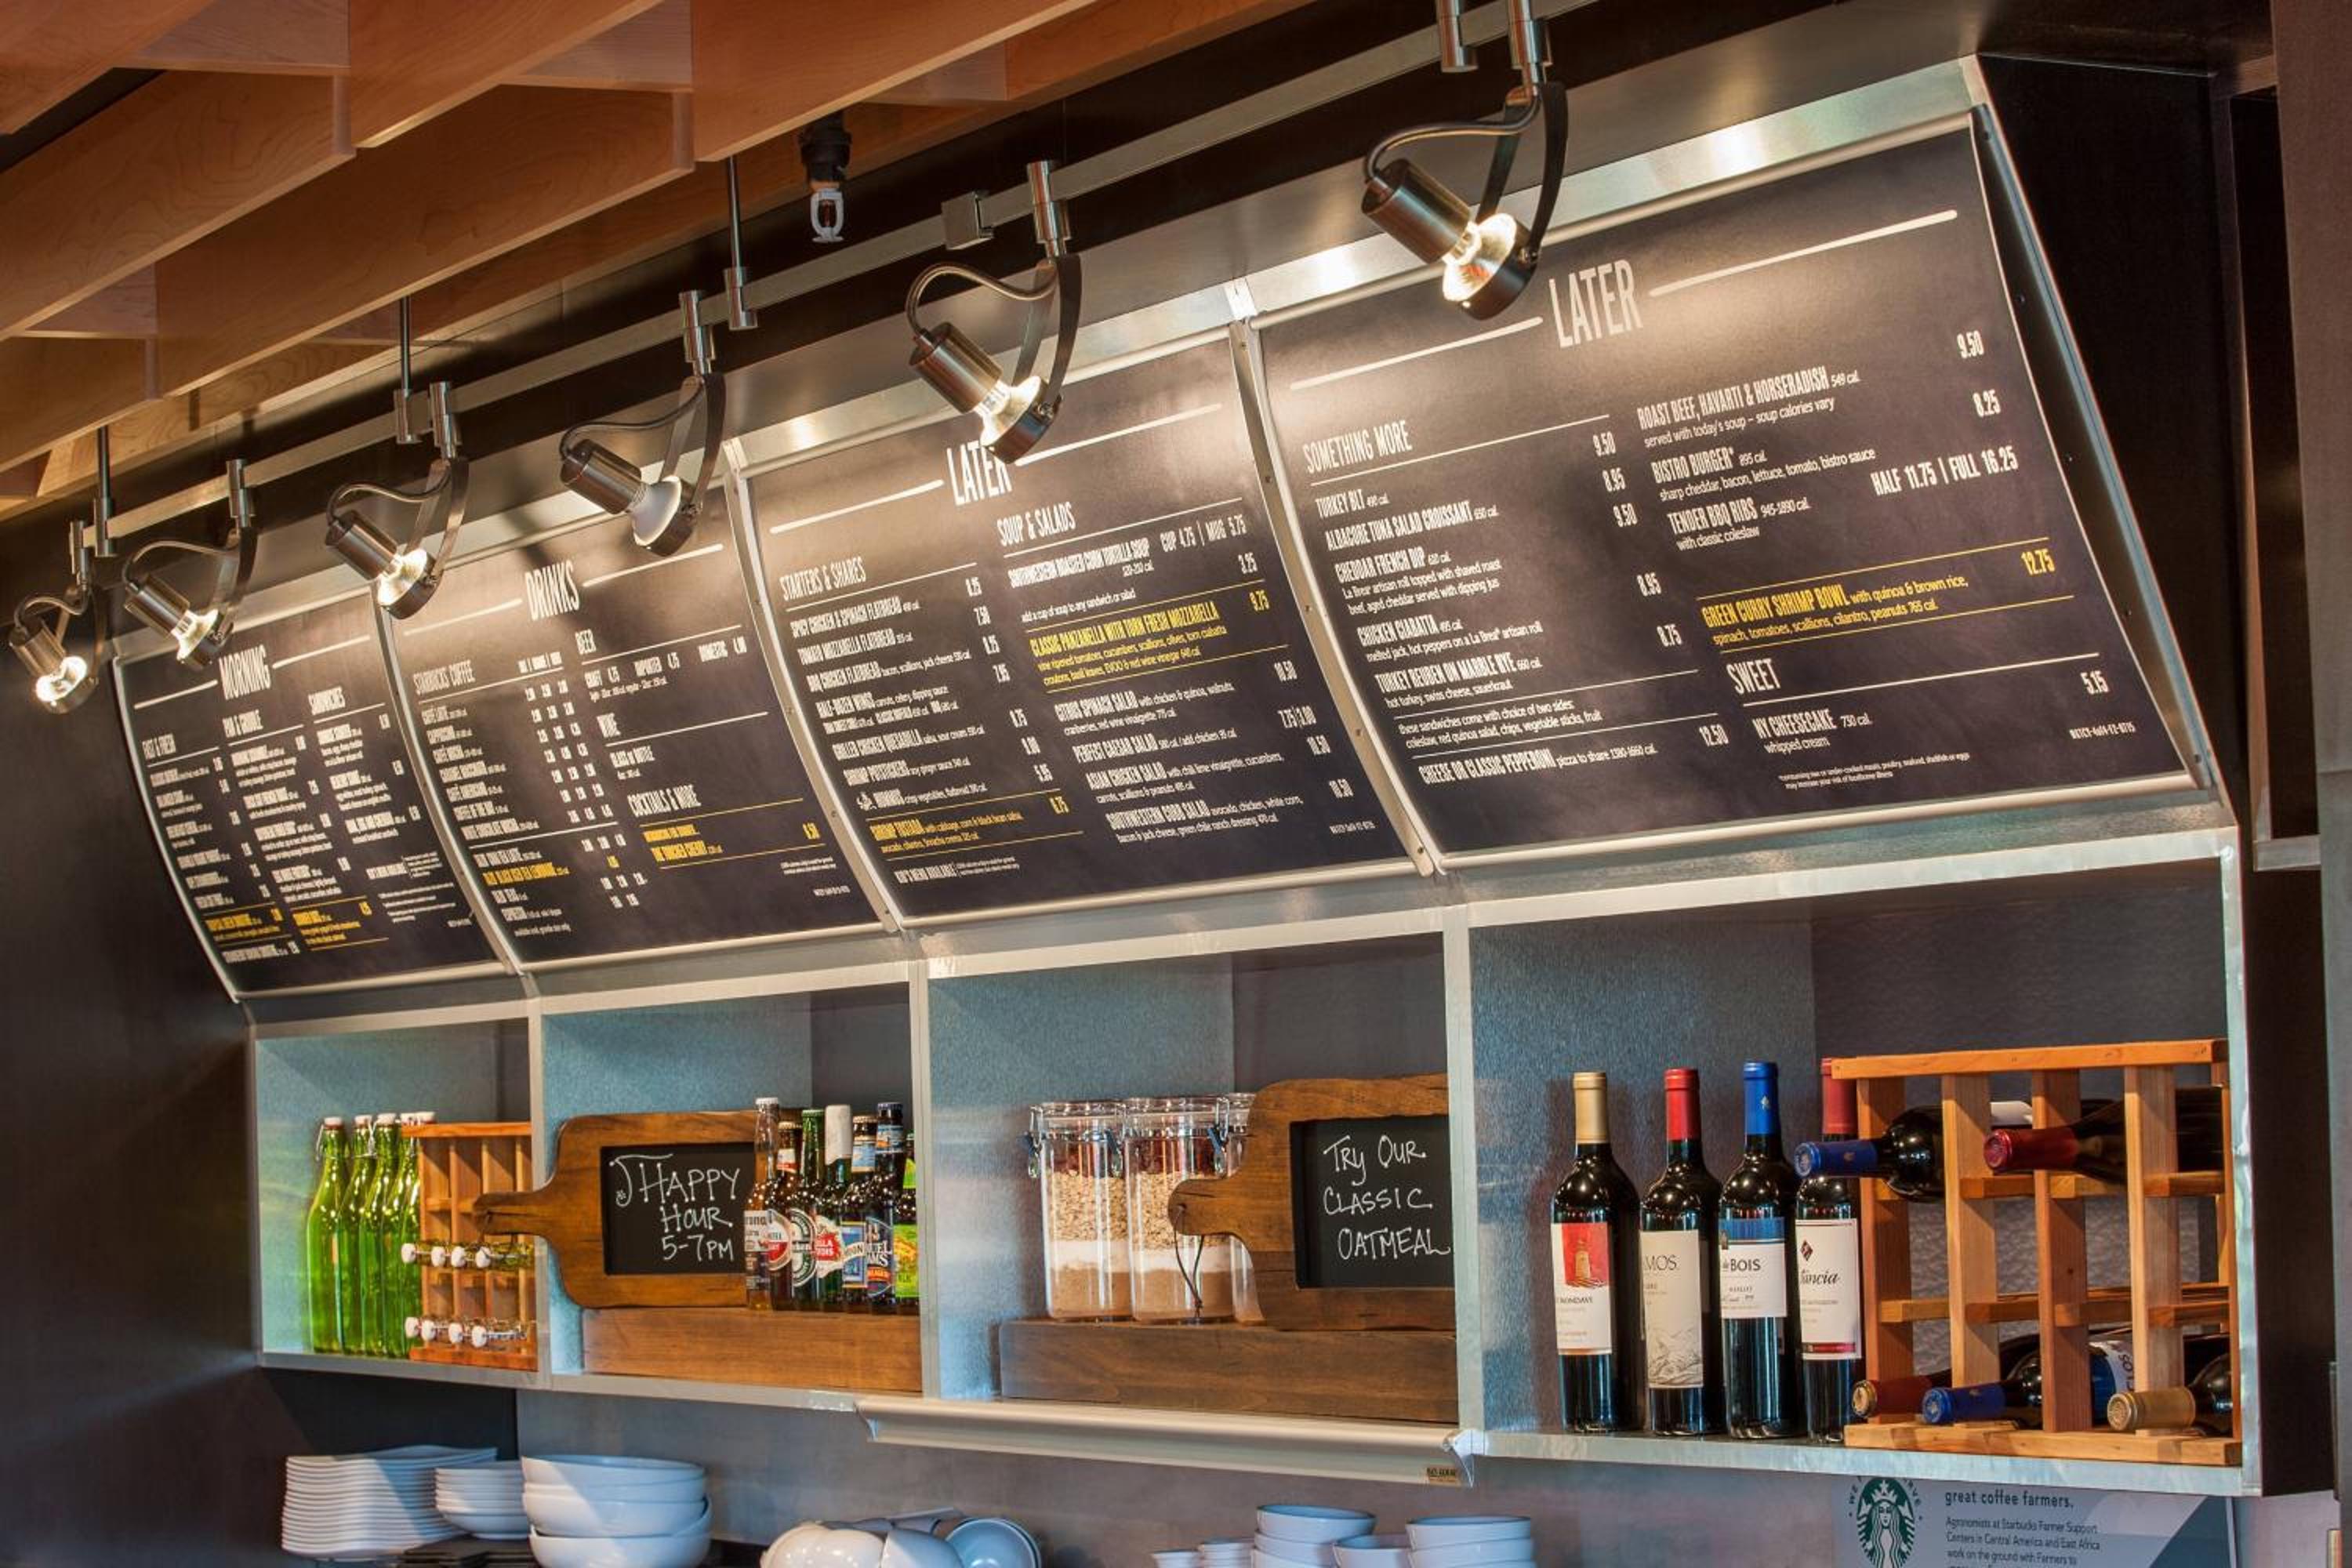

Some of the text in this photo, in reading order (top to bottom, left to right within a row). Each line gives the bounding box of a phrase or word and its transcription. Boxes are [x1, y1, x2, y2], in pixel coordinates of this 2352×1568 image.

[1548, 259, 1643, 348] LATER
[1958, 331, 1984, 359] 9.50
[1636, 401, 1671, 430] ROAST
[1669, 395, 1700, 423] BEEF,
[1697, 385, 1744, 416] HAVARTI
[1743, 383, 1755, 406] &
[1752, 365, 1830, 404] HORSERADISH
[1973, 390, 2000, 417] 8.25
[1644, 430, 1673, 448] served
[1672, 426, 1693, 441] with
[1724, 416, 1747, 430] soup
[1755, 409, 1778, 424] soup
[1779, 401, 1814, 419] calories
[1813, 397, 1835, 412] vary
[1301, 419, 1413, 474] SOMETHING MORE
[1592, 432, 1617, 457] 9.50
[946, 440, 1012, 506] LATER
[1650, 456, 1690, 484] BISTRO
[1660, 488, 1685, 502] sharp
[1819, 453, 1848, 470] bistro
[1848, 448, 1876, 463] sauce
[1870, 445, 2019, 495] HALF 11.75 FULL 16.25
[1314, 488, 1366, 518] TURKEY BLT
[1613, 503, 1637, 527] 9.50
[1667, 506, 1710, 535] TENDER
[1705, 502, 1733, 528] BBQ
[1728, 496, 1759, 523] RIBS
[996, 501, 1076, 547] SOUP & SALADS
[1367, 517, 1395, 542] TUNA
[1392, 511, 1424, 537] SALAD
[776, 555, 866, 601] STARTERS & SHARES
[2021, 550, 2055, 576] 12.75
[525, 560, 579, 620] DRINKS
[1636, 573, 1661, 597] 8.95
[1701, 602, 1740, 628] GREEN
[1735, 597, 1774, 622] CURRY
[1771, 589, 1815, 616] SHRIMP
[1813, 583, 1851, 609] BOWL
[1849, 589, 1873, 604] with
[1912, 579, 1947, 594] brown
[1657, 625, 1682, 648] 8.75
[220, 644, 271, 700] MORNING
[1726, 658, 1780, 695] SWEET
[1699, 724, 1729, 747] 12.50
[1751, 717, 1772, 739] NY
[1768, 708, 1838, 737] CHEESECAKE
[1418, 762, 1456, 785] CHEESE
[1464, 755, 1507, 779] CLASSIC
[1501, 747, 1557, 774] PEPPERONI
[1323, 1186, 1433, 1215] CLASSIC
[1338, 1227, 1450, 1260] OATMEAL
[1730, 1258, 1762, 1272] BOIS
[1945, 1491, 1976, 1506] great
[1981, 1490, 2019, 1504] coffee
[2002, 1519, 2037, 1531] Starbucks
[2038, 1521, 2065, 1531] Farmer
[2067, 1522, 2098, 1534] Support
[1984, 1534, 2012, 1545] Central
[2013, 1535, 2042, 1547] America
[2044, 1537, 2060, 1548] and
[2078, 1538, 2100, 1551] Africa
[1991, 1550, 2019, 1563] ground
